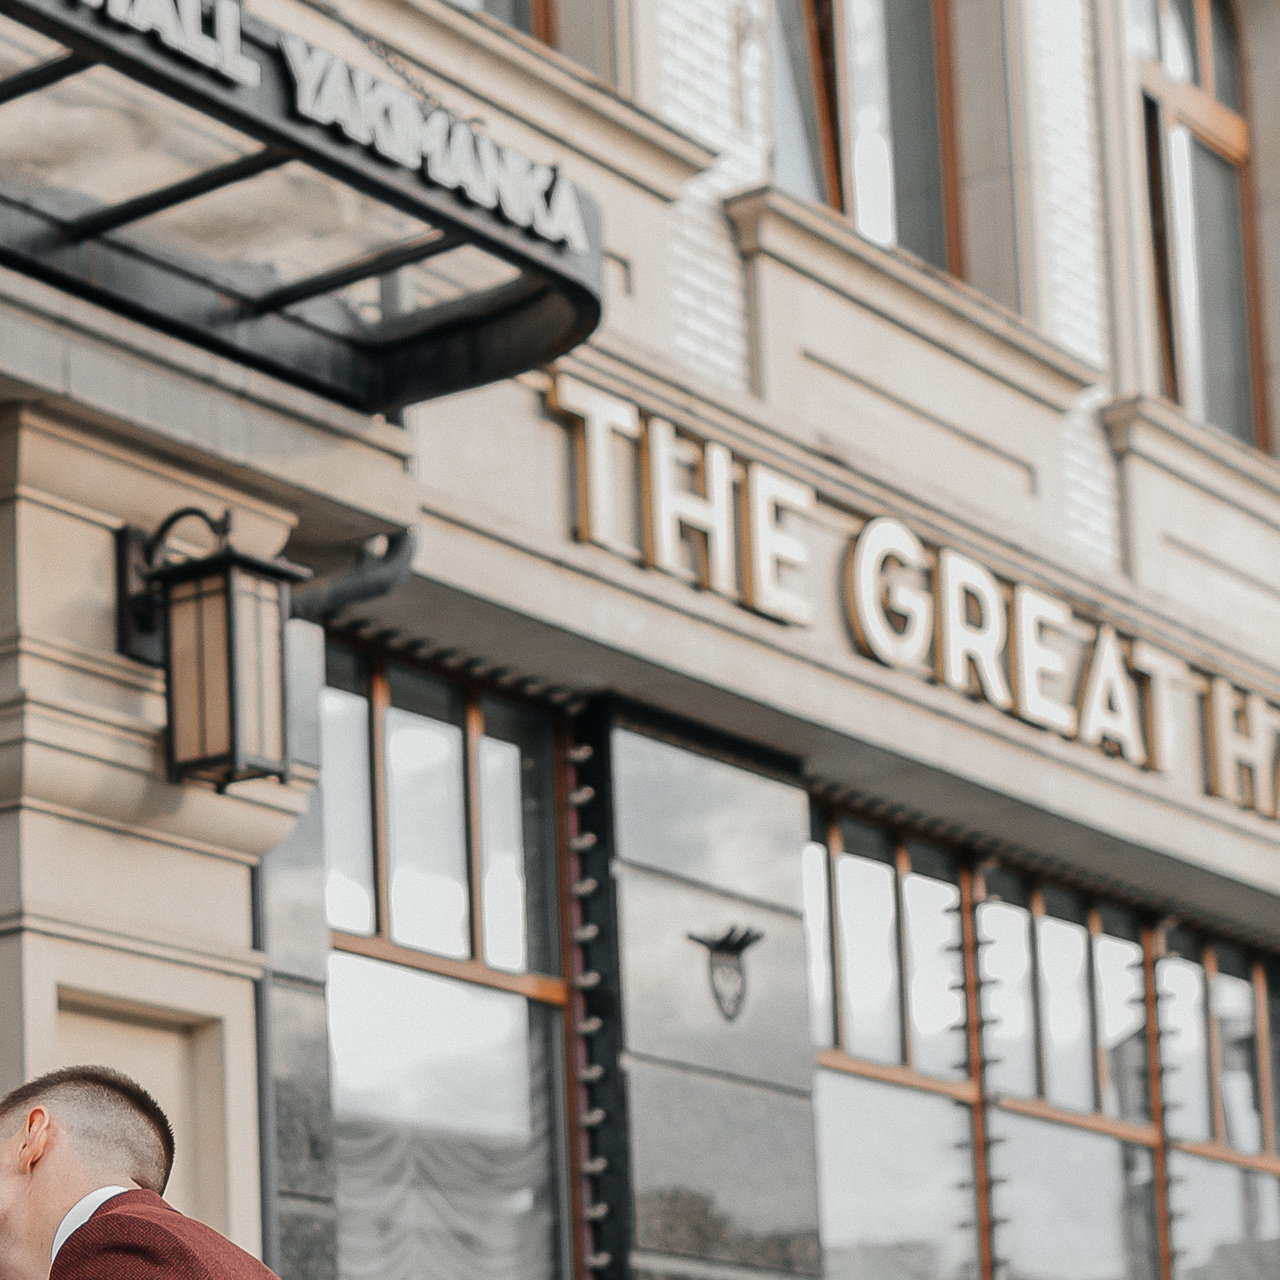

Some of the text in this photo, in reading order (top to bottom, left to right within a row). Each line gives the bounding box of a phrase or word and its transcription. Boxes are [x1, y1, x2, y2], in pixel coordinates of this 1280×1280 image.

[83, 0, 590, 254] ALL YAKIMANKA
[552, 368, 818, 627] THE
[846, 515, 1209, 800] GREAT
